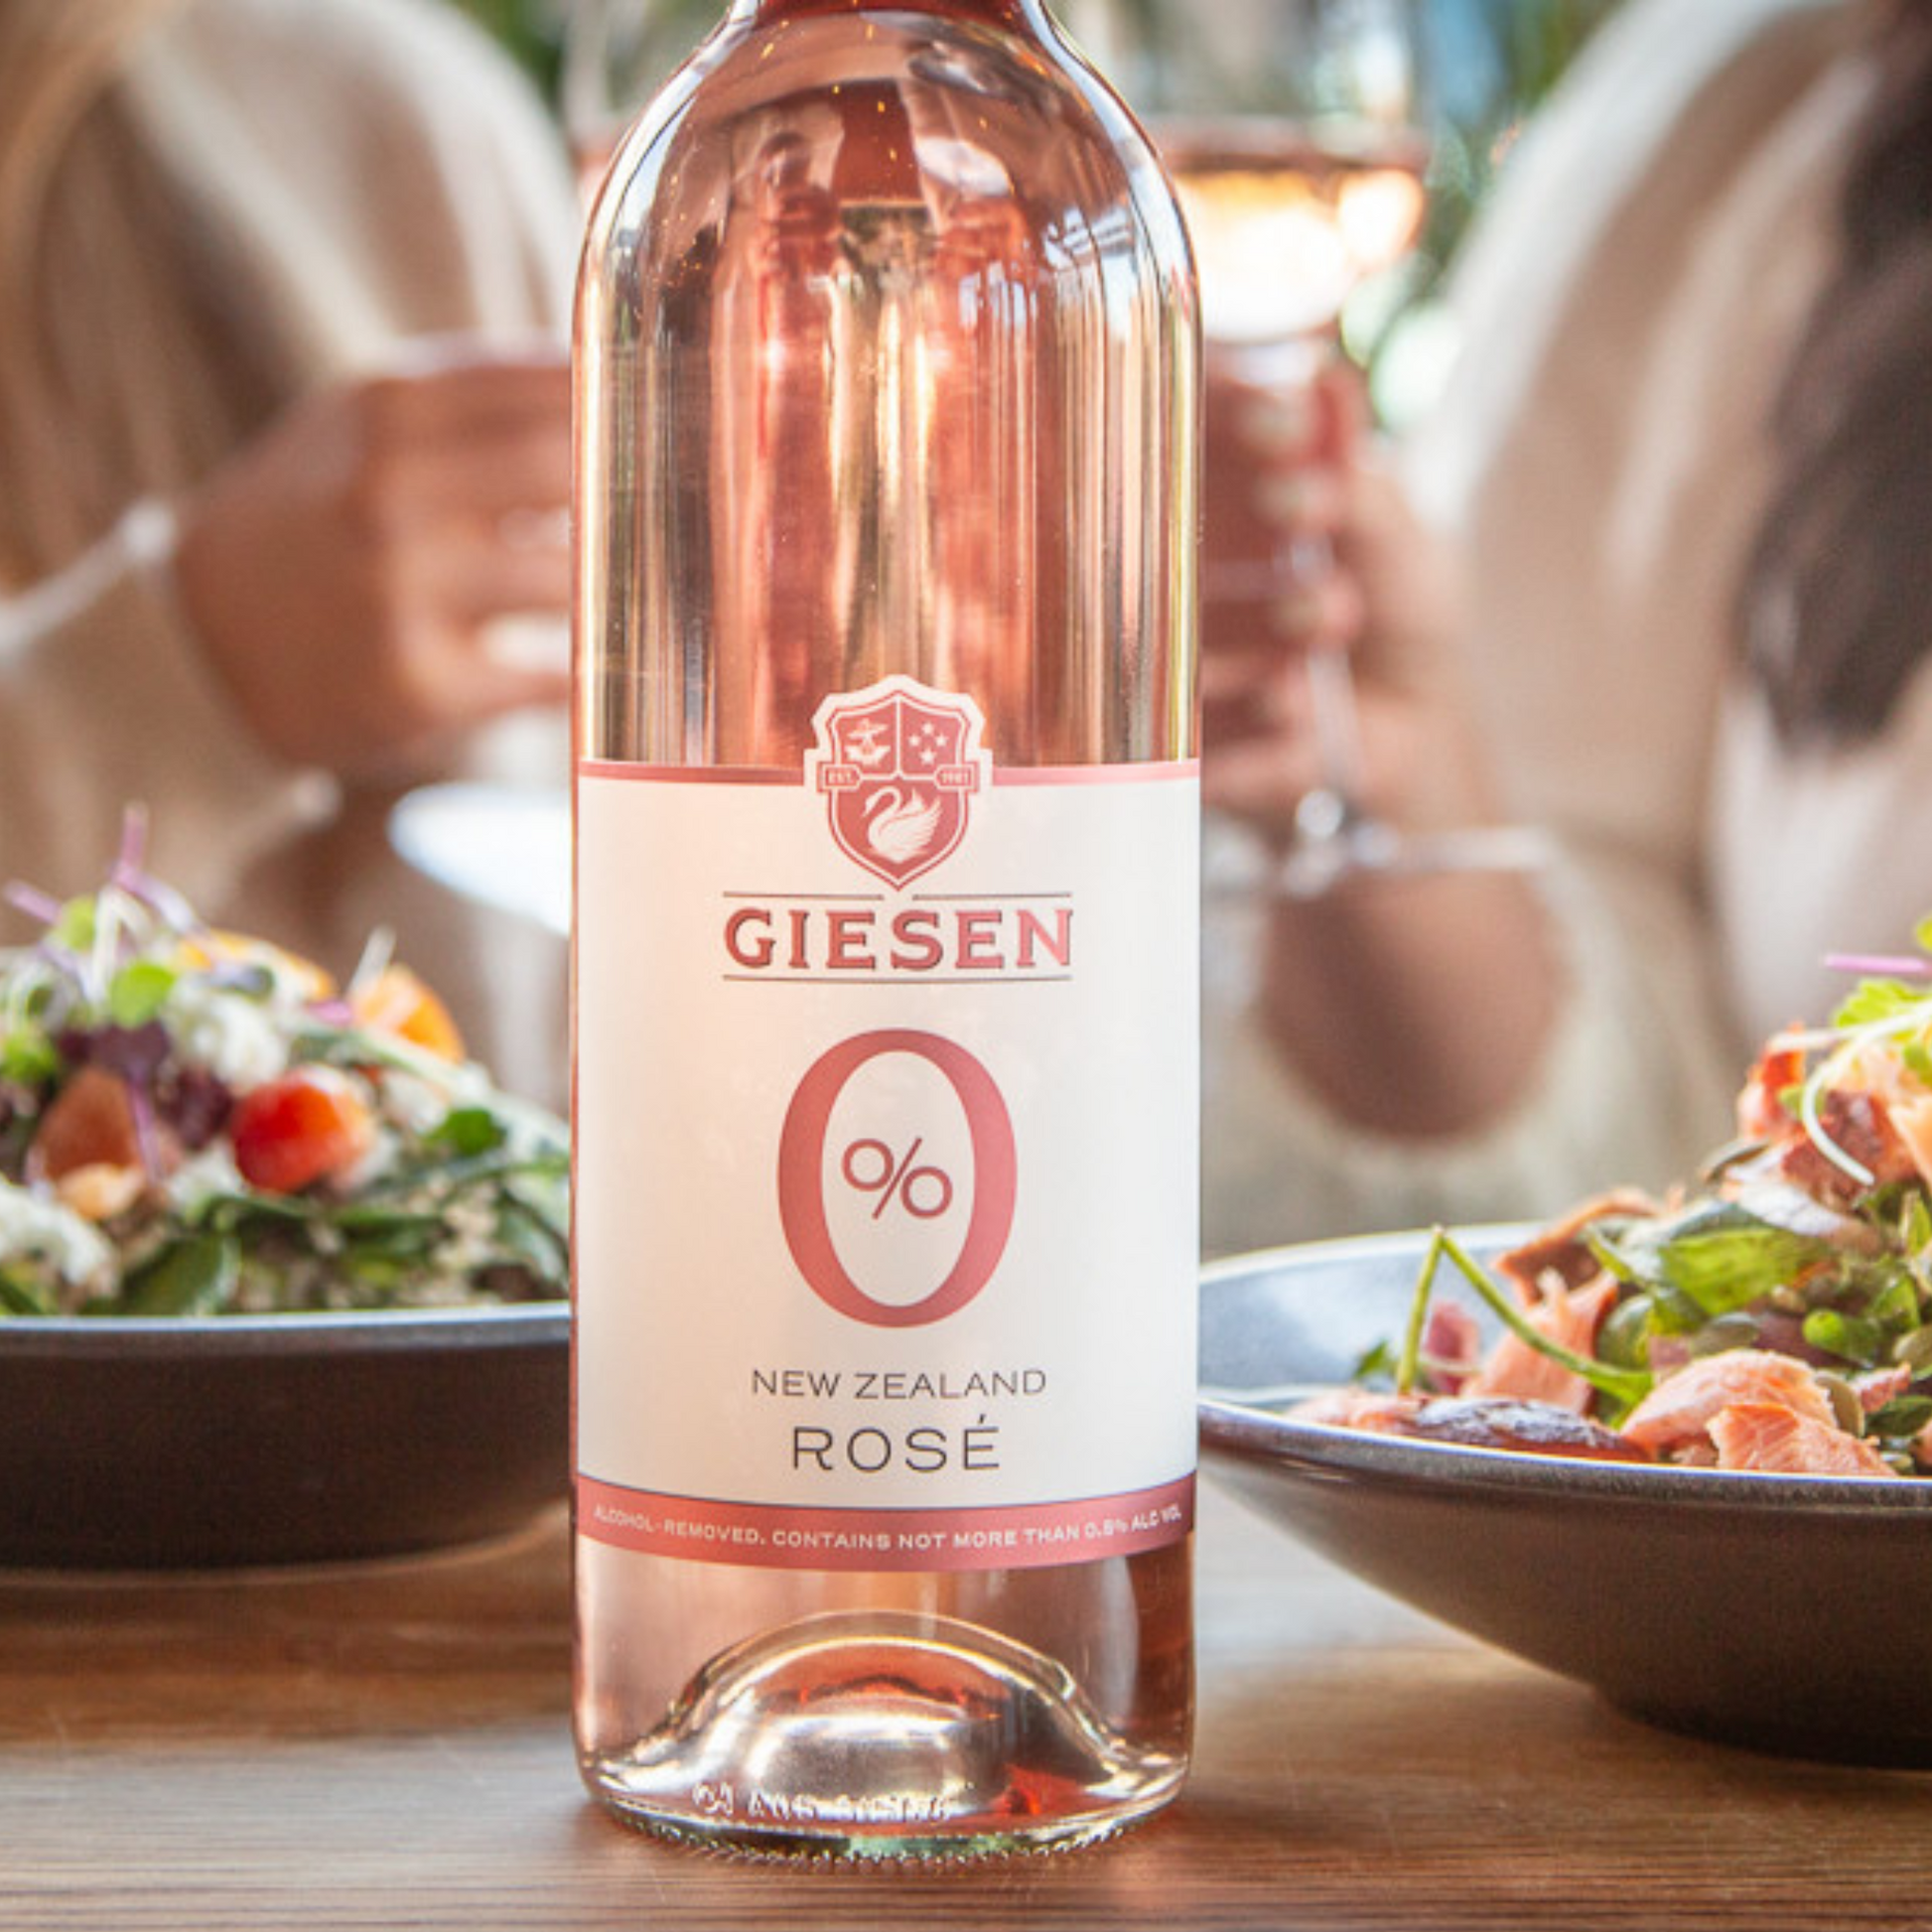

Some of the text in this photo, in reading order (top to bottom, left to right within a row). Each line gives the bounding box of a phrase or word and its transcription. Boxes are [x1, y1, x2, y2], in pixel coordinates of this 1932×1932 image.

[724, 907, 1072, 969] GIESEN
[752, 1369, 1046, 1400] NEW ZEALAND
[793, 1414, 1000, 1471] ROSÉ
[771, 1529, 892, 1551] CONTAINS
[897, 1533, 947, 1550] NOT
[952, 1530, 1018, 1549] MORE
[1023, 1524, 1079, 1546] THAN
